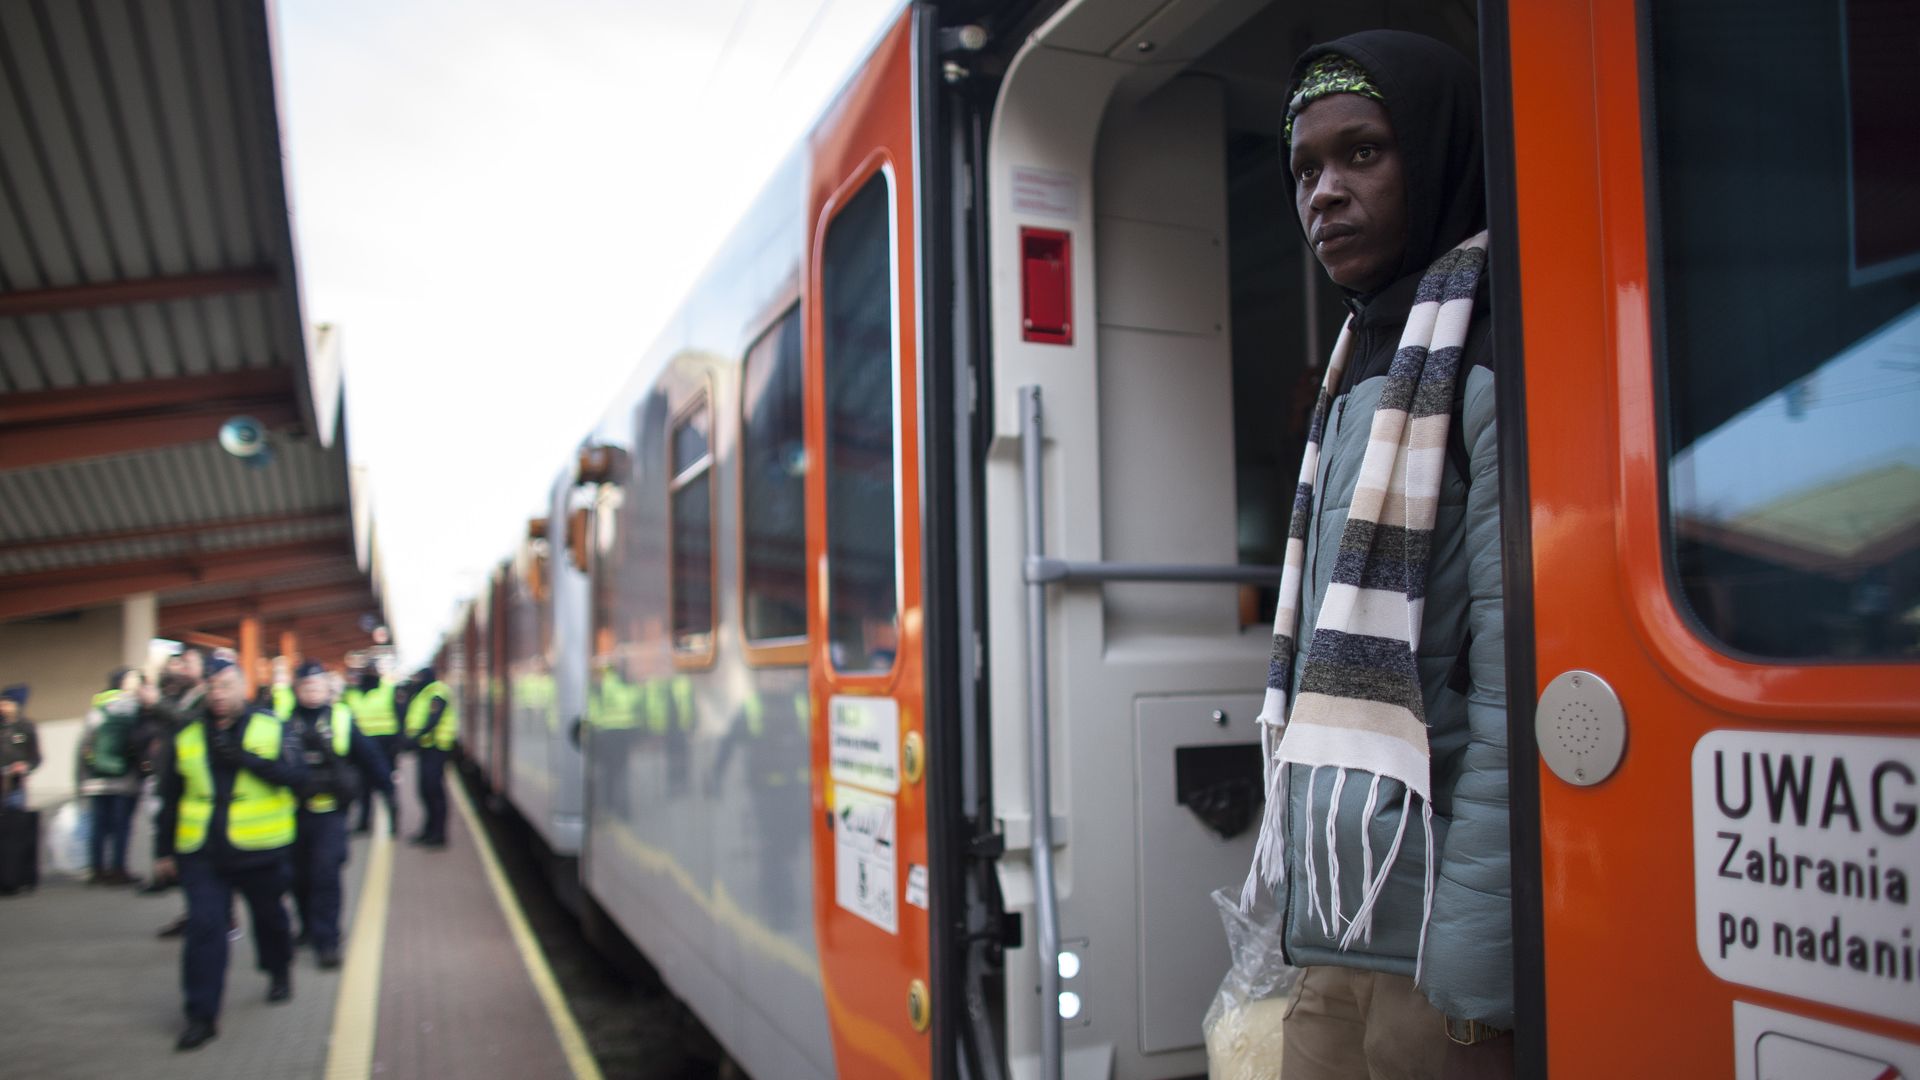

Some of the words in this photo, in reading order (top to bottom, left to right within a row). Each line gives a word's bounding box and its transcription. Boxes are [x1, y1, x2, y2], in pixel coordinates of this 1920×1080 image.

[1714, 749, 1919, 838] UWAG
[1716, 831, 1909, 906] Zabrania
[1719, 911, 1760, 961] po
[1773, 916, 1920, 983] nadani
